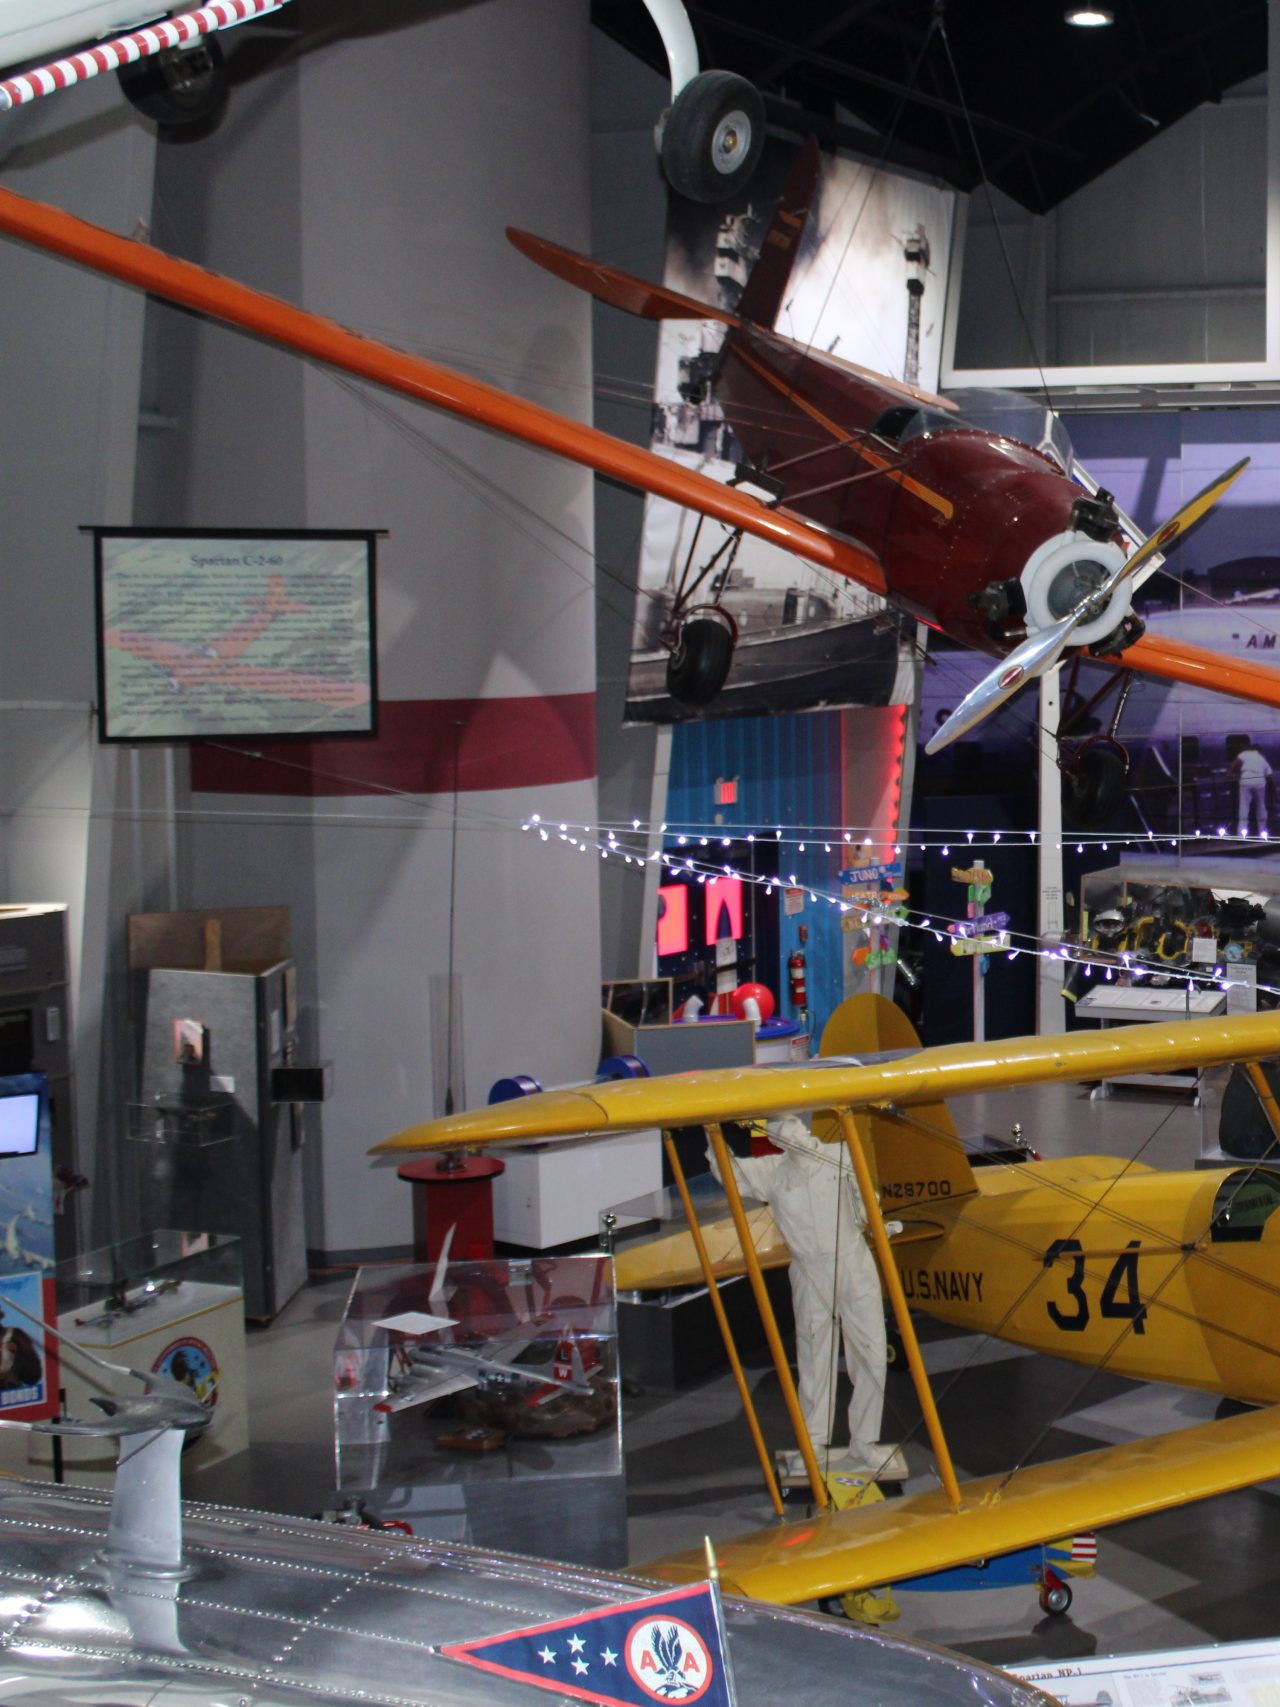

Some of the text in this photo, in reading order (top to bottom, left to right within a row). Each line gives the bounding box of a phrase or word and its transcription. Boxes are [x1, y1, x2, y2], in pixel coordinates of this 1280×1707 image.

[190, 555, 240, 569] Spartan
[882, 1180, 950, 1198] N28700
[1043, 1239, 1148, 1334] 34
